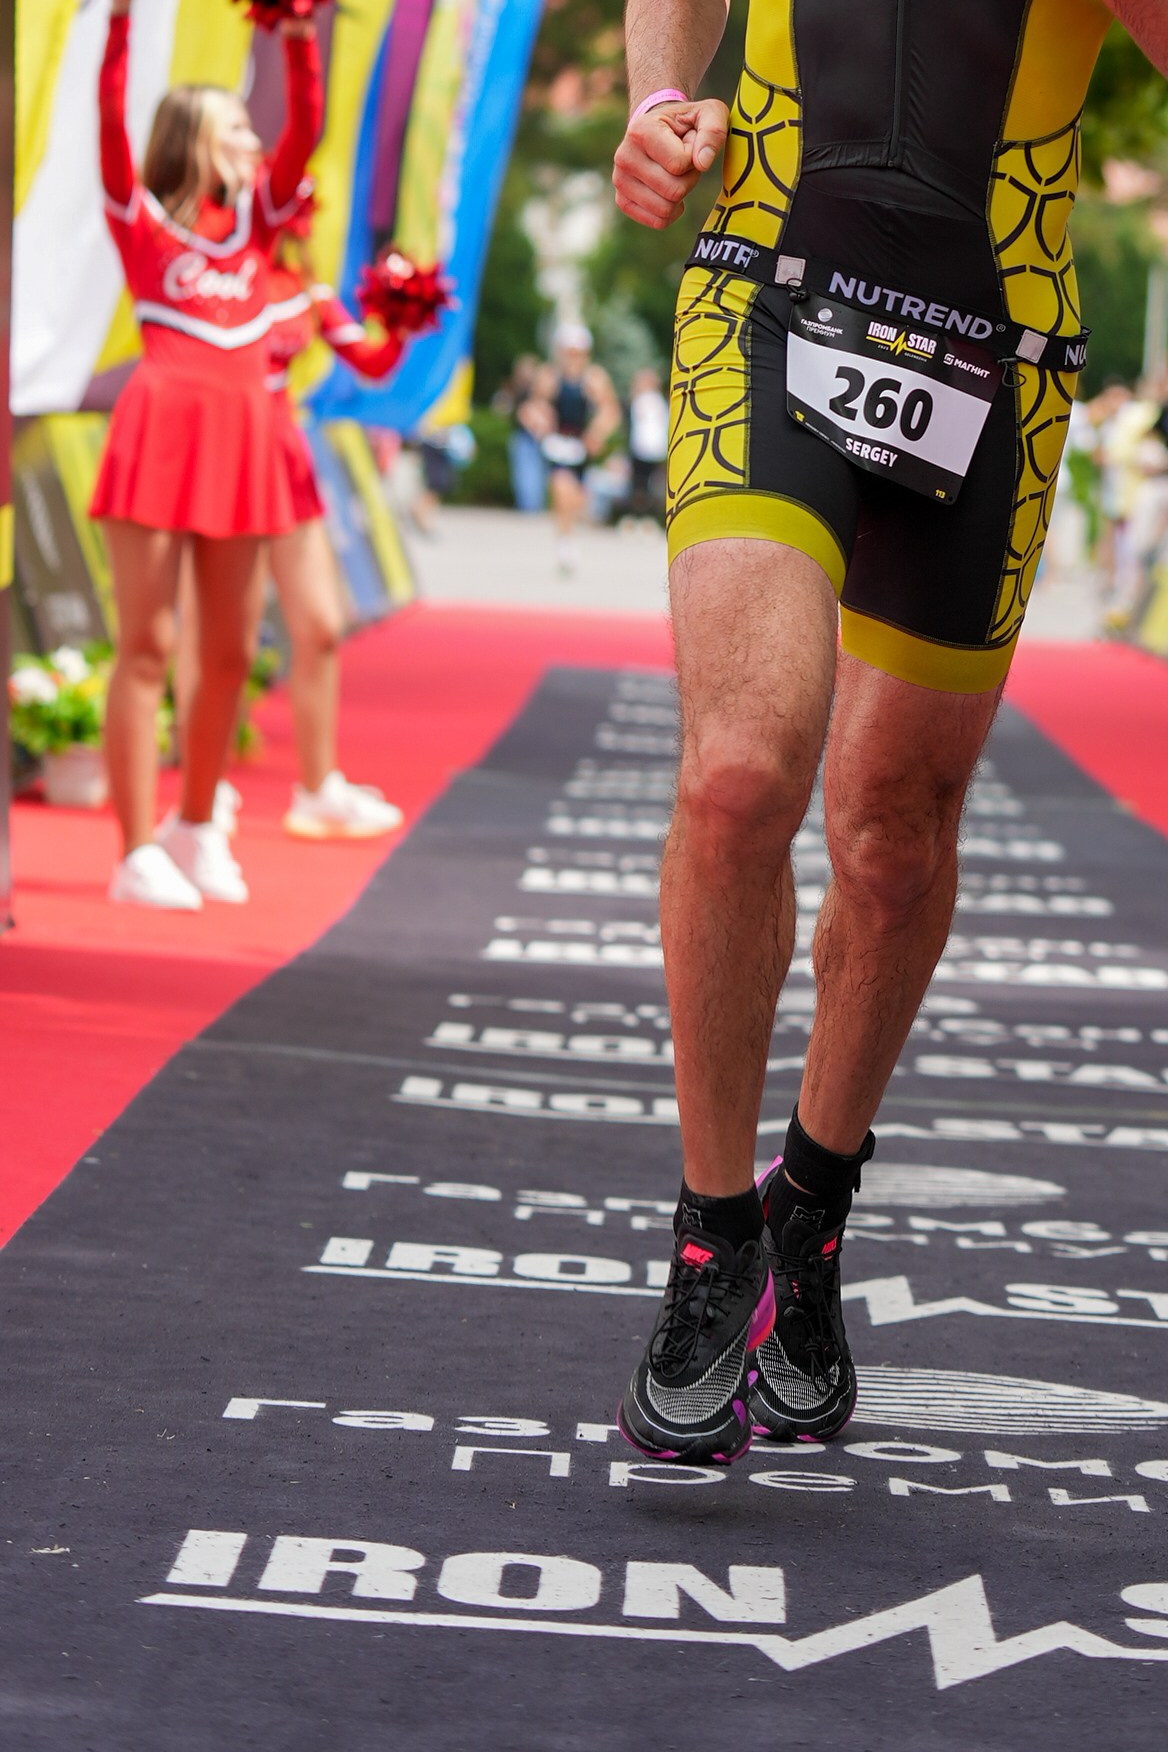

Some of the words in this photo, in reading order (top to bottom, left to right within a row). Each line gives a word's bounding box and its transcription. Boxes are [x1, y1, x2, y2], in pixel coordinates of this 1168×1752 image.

[828, 271, 993, 341] NUTREND
[867, 321, 898, 342] IRON
[907, 333, 937, 355] STAR
[953, 357, 991, 379] МАГНИТ
[828, 365, 934, 443] 260
[845, 437, 898, 468] SERGEY
[401, 1076, 680, 1117] IRO
[320, 1236, 671, 1289] IRO
[165, 1529, 787, 1624] IRON
